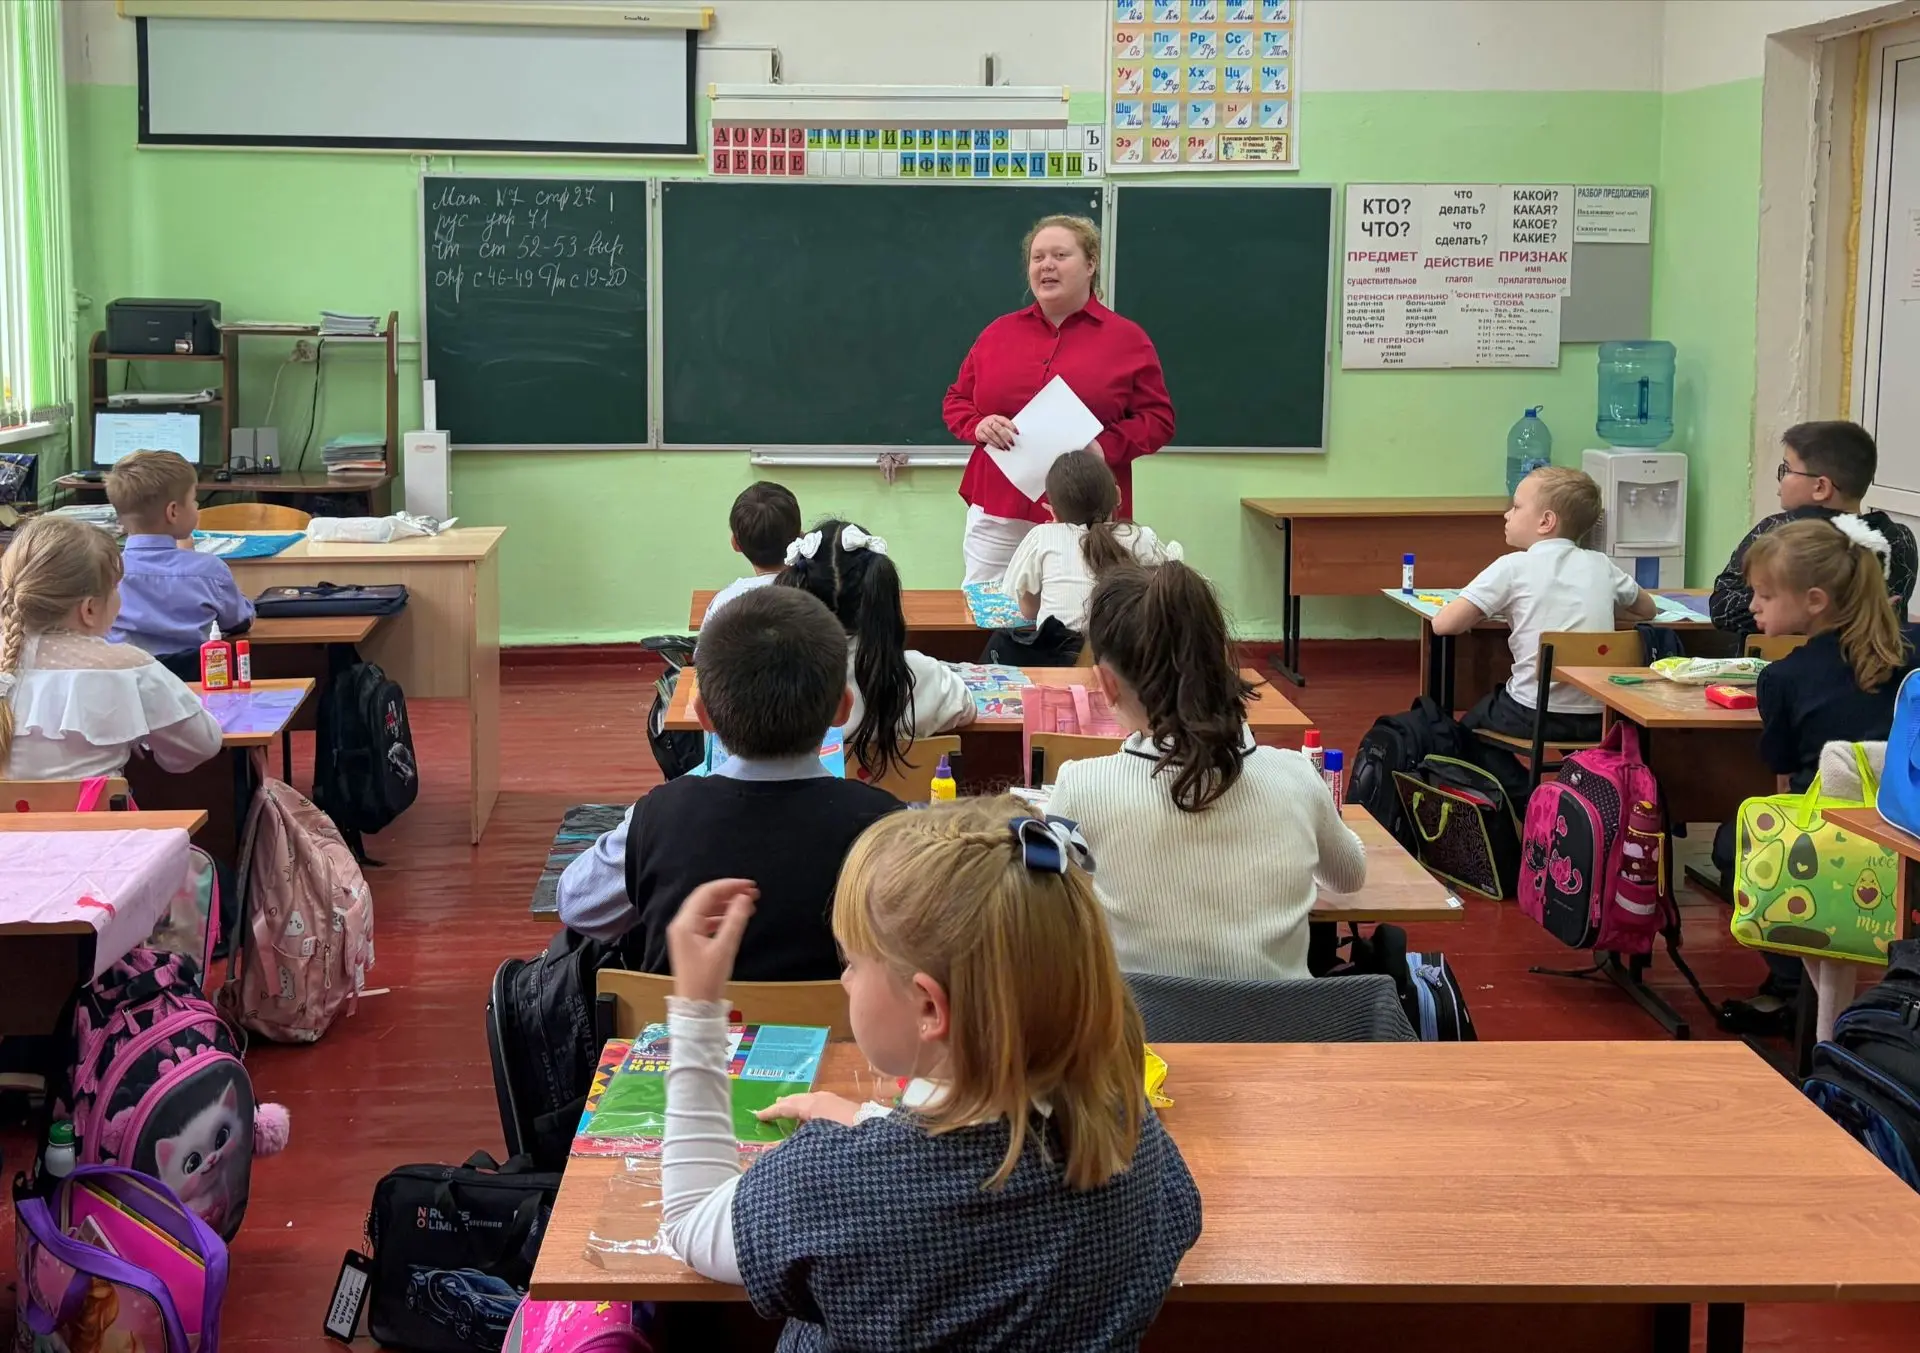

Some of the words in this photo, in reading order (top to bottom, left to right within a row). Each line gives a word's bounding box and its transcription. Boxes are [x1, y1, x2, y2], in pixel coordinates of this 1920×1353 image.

[1116, 32, 1133, 43] Оо
[1154, 32, 1169, 42] Пп
[1190, 32, 1205, 44] Рр
[1225, 32, 1241, 43] Сс
[1264, 32, 1277, 42] Тт
[1118, 67, 1132, 79] Уу
[1152, 67, 1168, 80] Фф
[1189, 67, 1204, 77] Хх
[1225, 67, 1240, 78] Цц
[1262, 67, 1277, 77] Чч
[1116, 103, 1131, 114] Шш
[1152, 103, 1168, 114] Щщ
[716, 128, 728, 142] А
[735, 128, 746, 142] О
[753, 128, 765, 143] У
[771, 128, 786, 143] Ы
[792, 128, 802, 144] Э
[809, 129, 821, 144] Л
[828, 129, 841, 144] М
[847, 129, 859, 144] Н
[866, 129, 875, 144] Р
[884, 129, 896, 144] И
[903, 130, 913, 144] Б
[922, 130, 932, 144] В
[941, 130, 950, 144] Г
[957, 130, 969, 148] Д
[974, 130, 990, 145] Ж
[996, 130, 1005, 145] З
[1087, 130, 1099, 144] Ъ
[1116, 137, 1131, 147] Ээ
[1152, 137, 1170, 147] Юю
[1188, 137, 1204, 147] Яя
[716, 154, 727, 169] Я
[736, 151, 746, 169] Ё
[752, 154, 767, 169] Ю
[772, 155, 784, 170] И
[792, 155, 802, 170] Е
[903, 157, 916, 172] П
[920, 157, 934, 172] Ф
[939, 157, 952, 172] К
[958, 157, 971, 172] Т
[975, 157, 990, 172] Ш
[996, 157, 1005, 172] С
[1012, 157, 1025, 172] Х
[1032, 158, 1044, 174] Ц
[1050, 157, 1062, 172] Ч
[1067, 157, 1082, 174] Щ
[1088, 158, 1098, 172] Ь
[573, 185, 596, 207] 27
[1454, 190, 1472, 199] что
[1514, 189, 1558, 201] КАКОЙ?
[1578, 188, 1602, 198] РАЗБОР
[1603, 189, 1649, 198] ПРЕДЛОЖЕНИЯ
[1363, 198, 1411, 214] КТО?
[1439, 204, 1486, 216] делать?
[1514, 205, 1558, 215] КАКАЯ?
[1361, 221, 1410, 237] ЧТО?
[1453, 222, 1472, 230] что
[1513, 219, 1557, 229] КАКОЕ?
[1436, 234, 1488, 246] сделать?
[1513, 233, 1557, 243] КАКИЕ?
[517, 234, 577, 259] 52-53
[1348, 252, 1418, 263] ПРЕДМЕТ
[1424, 256, 1494, 269] ДЕЙСТВИЕ
[1499, 251, 1568, 263] ПРИЗНАК
[488, 265, 533, 287] 46-49
[584, 268, 627, 288] 19-20
[1347, 277, 1417, 286] существительное
[1498, 277, 1567, 285] прилагательное
